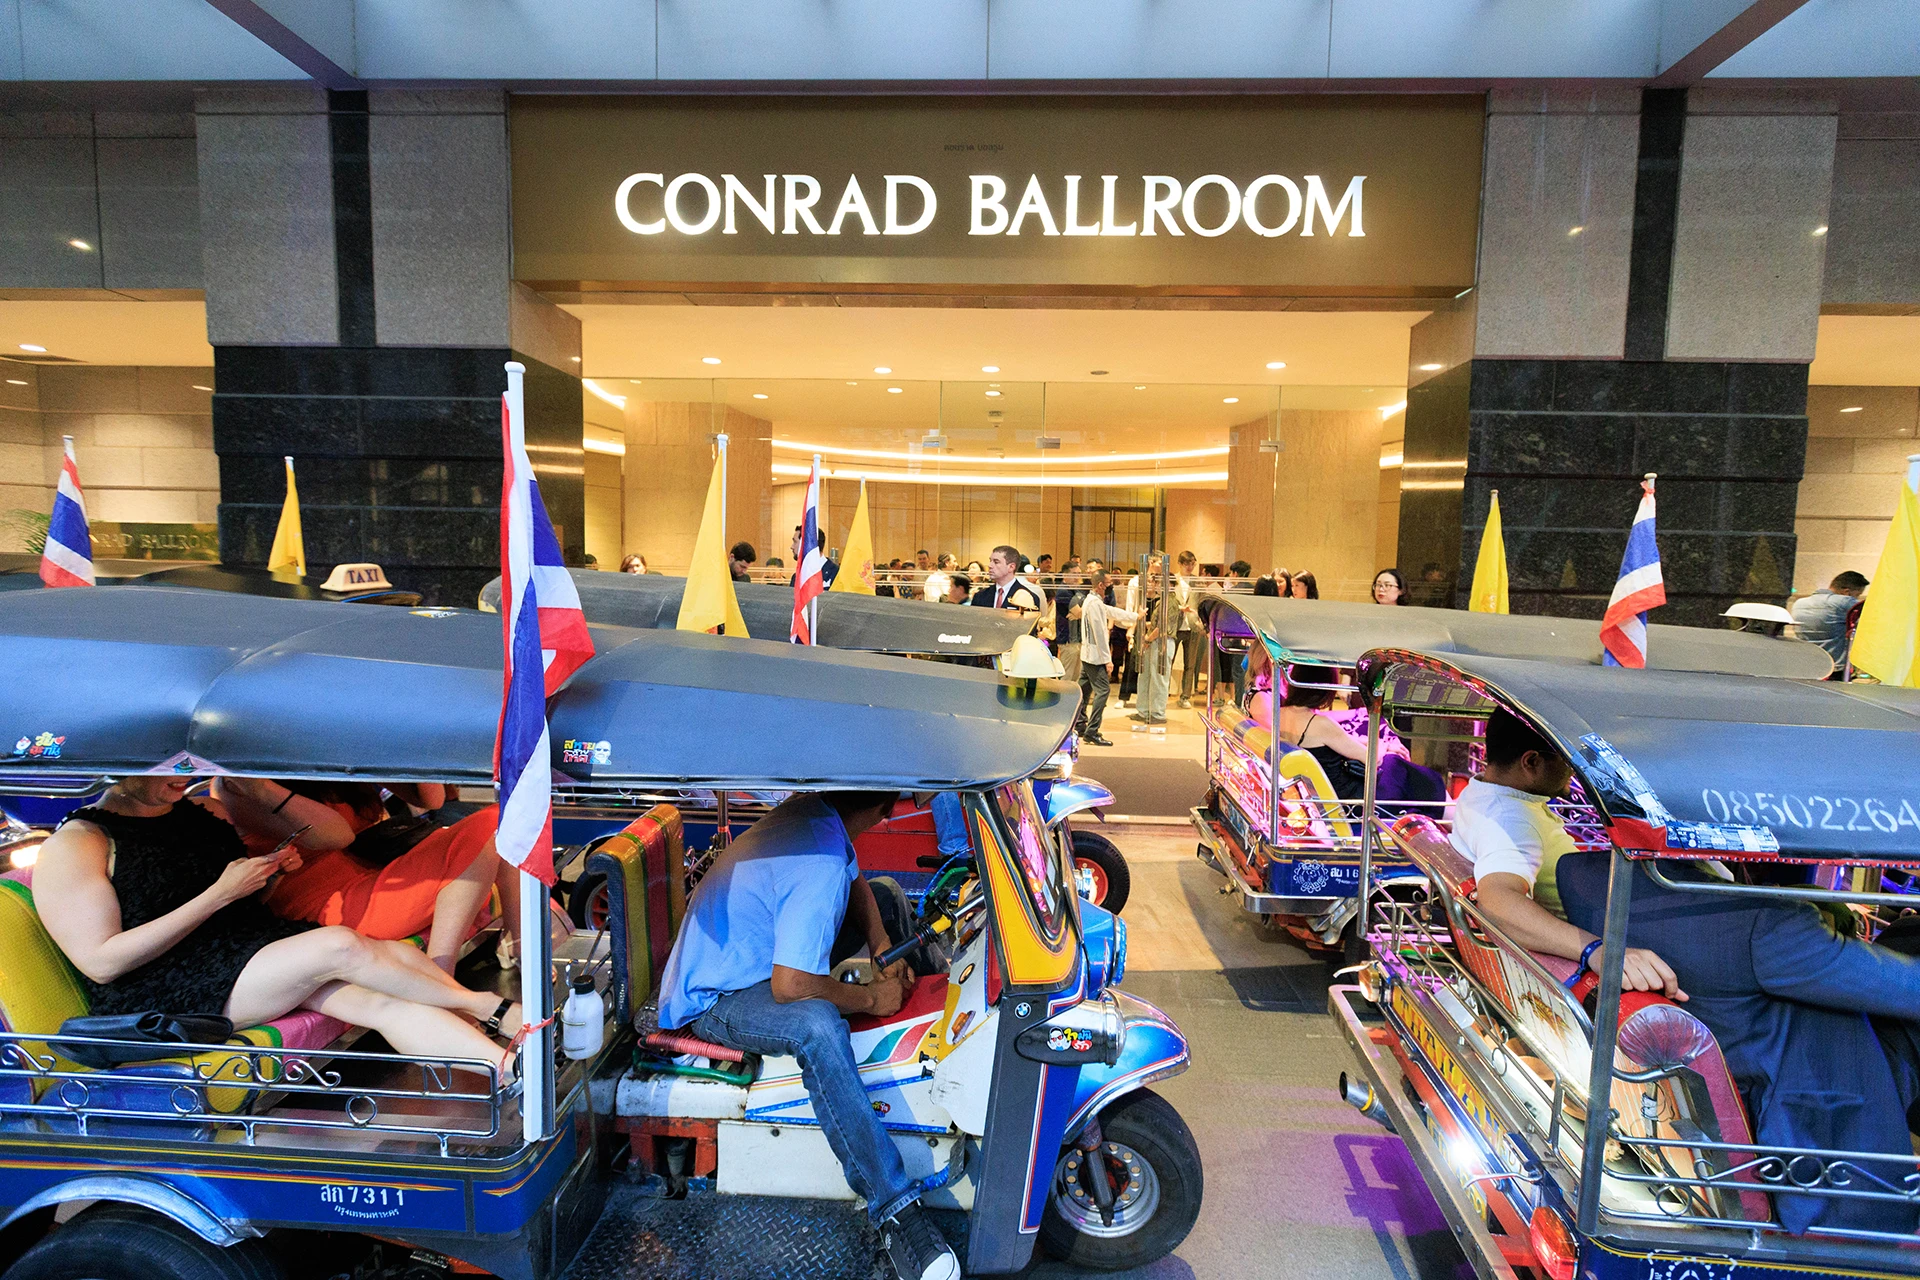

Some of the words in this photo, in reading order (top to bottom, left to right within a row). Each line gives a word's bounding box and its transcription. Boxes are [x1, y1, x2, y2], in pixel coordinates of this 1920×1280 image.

[614, 172, 937, 236] CONRAD
[968, 173, 1367, 238] BALLROOM
[348, 568, 379, 584] TAXI
[1346, 868, 1359, 878] 16
[347, 1186, 404, 1206] 7311
